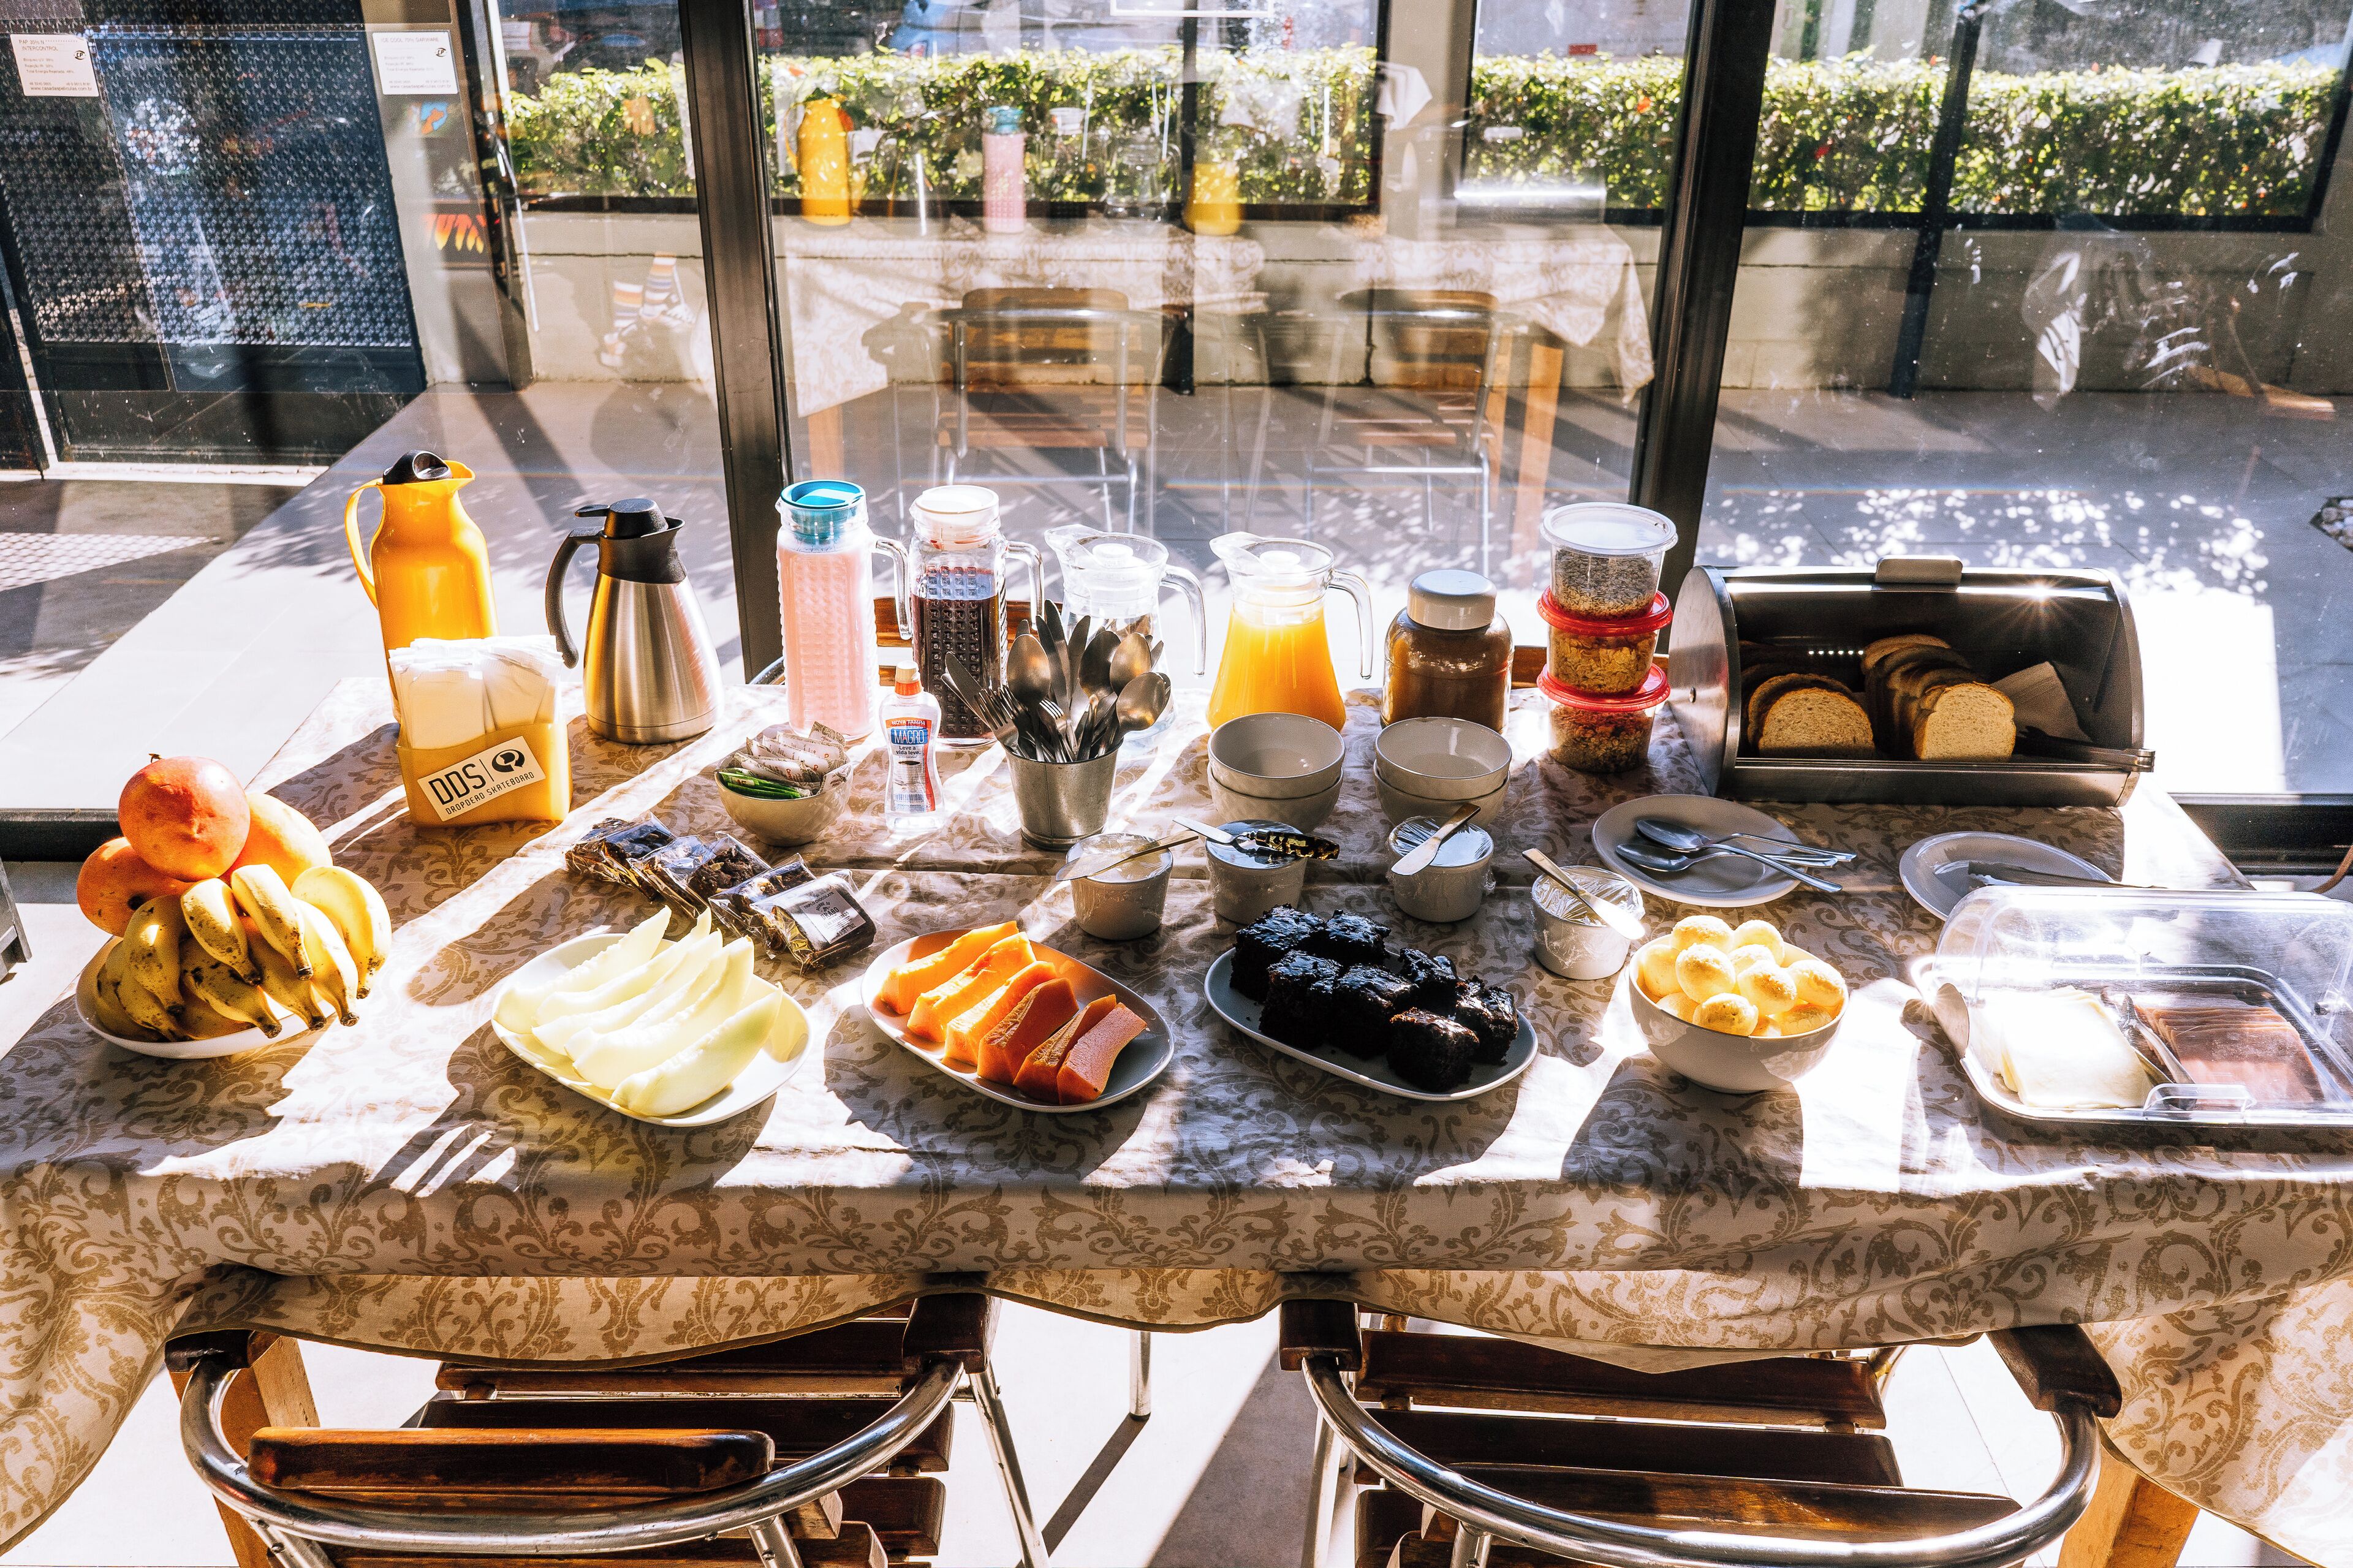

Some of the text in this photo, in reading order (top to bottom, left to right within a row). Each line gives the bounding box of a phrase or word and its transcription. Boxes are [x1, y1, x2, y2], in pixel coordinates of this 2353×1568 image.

[894, 729, 924, 743] MAGRO
[428, 763, 486, 805] DDS
[445, 771, 535, 815] DROPDEAD SKATEBOARD
[815, 892, 835, 903] CHOCOLATE
